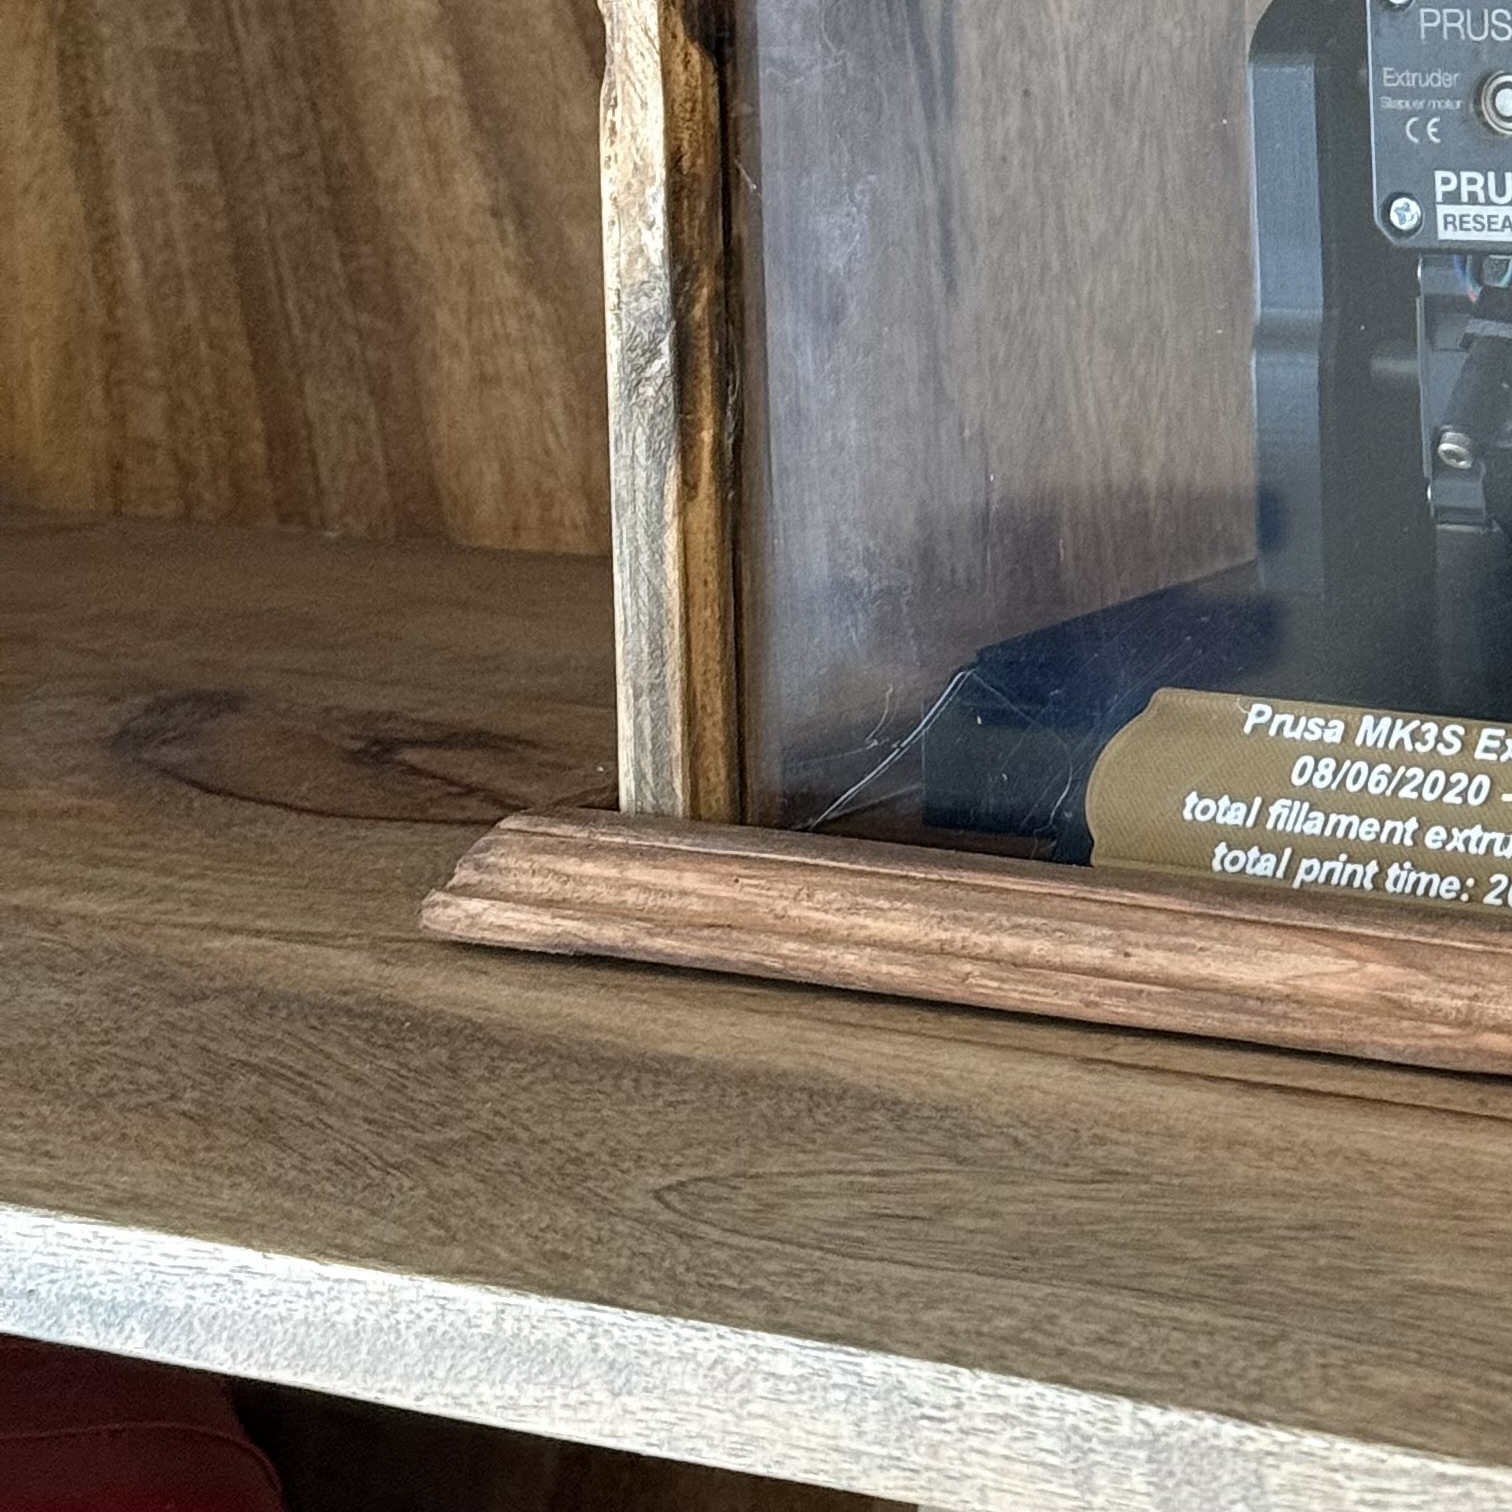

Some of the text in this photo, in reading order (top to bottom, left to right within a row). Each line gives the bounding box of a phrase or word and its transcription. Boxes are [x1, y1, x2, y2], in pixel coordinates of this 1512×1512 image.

[1382, 67, 1459, 88] Extruder
[1243, 703, 1345, 744] Prusa
[1354, 714, 1465, 756] MK3S
[1291, 755, 1491, 807] 08/06/2020
[1183, 791, 1262, 828] total
[1266, 799, 1419, 847] fillament
[1212, 841, 1292, 879] total
[1292, 853, 1379, 890] print
[1384, 861, 1475, 902] time:
